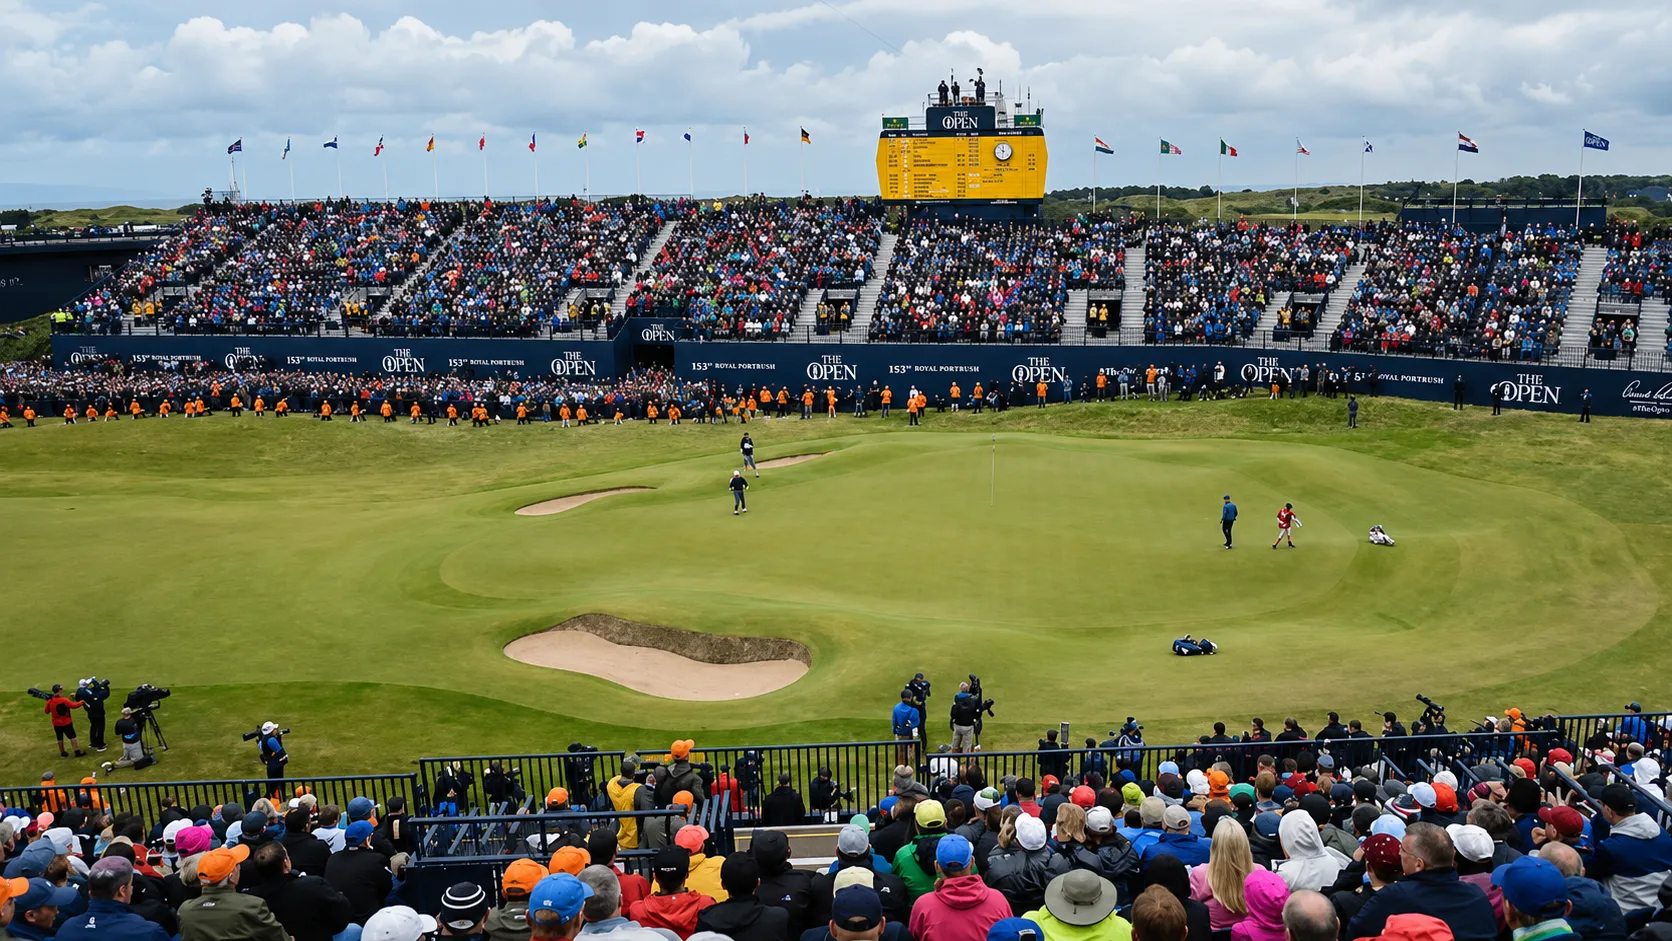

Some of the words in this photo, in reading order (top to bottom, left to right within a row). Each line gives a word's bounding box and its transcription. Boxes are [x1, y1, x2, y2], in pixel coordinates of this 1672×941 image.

[942, 116, 978, 129] OPEN
[641, 328, 675, 341] OPEN
[394, 348, 411, 357] THE
[563, 351, 582, 360] THE
[382, 355, 425, 373] OPEN
[821, 355, 842, 364] THE
[1027, 356, 1050, 366] THE
[1257, 356, 1279, 366] THE
[551, 358, 596, 376] OPEN
[807, 362, 857, 380] OPEN
[1012, 364, 1066, 383] OPEN
[1241, 363, 1294, 383] OPEN
[1377, 373, 1399, 381] OYAL
[1401, 375, 1444, 384] PORTRUSH
[1516, 373, 1543, 385] THE
[1499, 380, 1561, 404] OPEN
